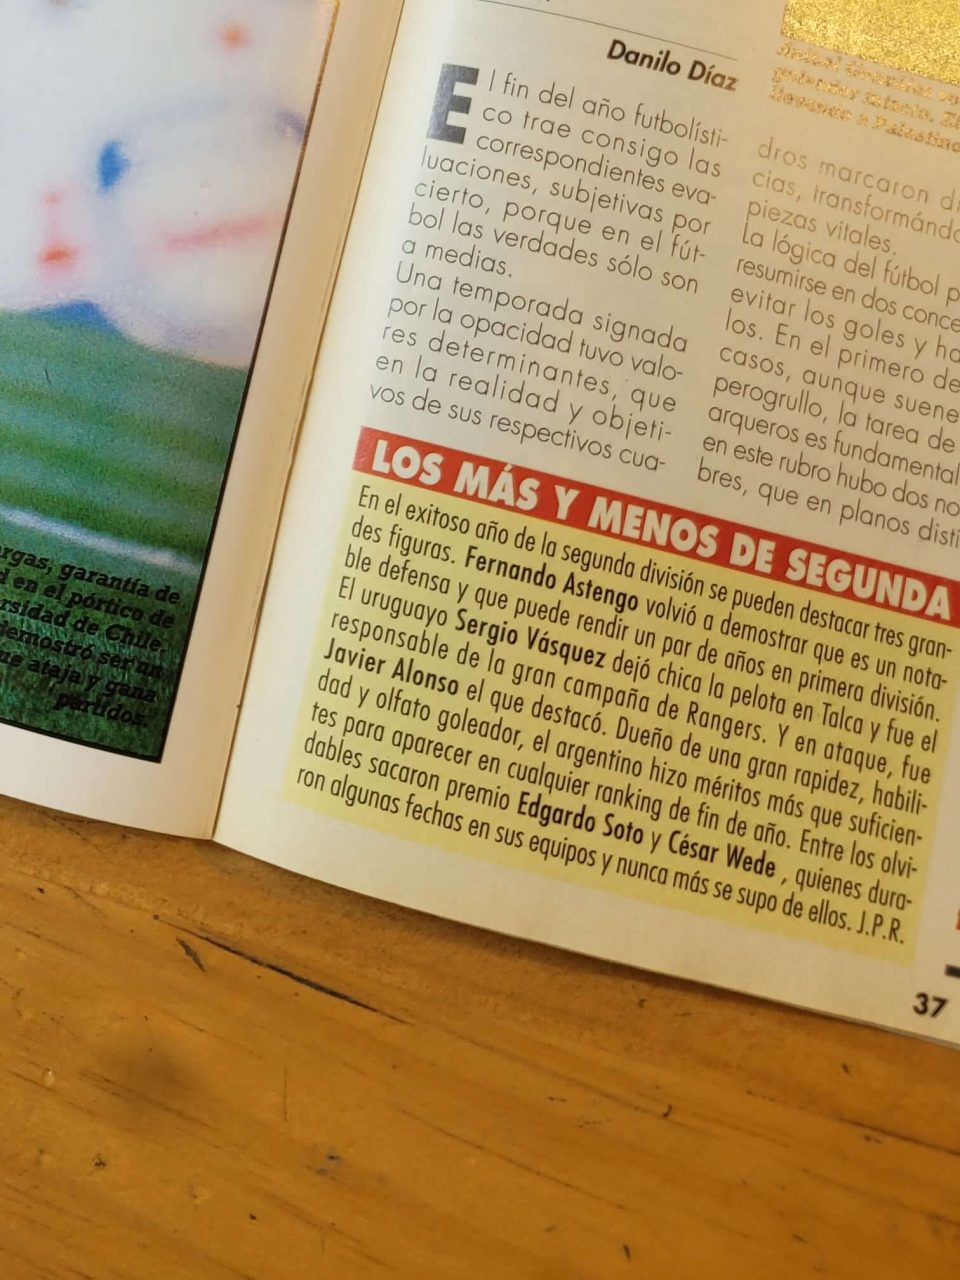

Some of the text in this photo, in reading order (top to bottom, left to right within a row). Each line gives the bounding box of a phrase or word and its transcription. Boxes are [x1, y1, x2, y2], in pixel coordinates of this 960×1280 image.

[606, 39, 738, 92] Danilo Díaz
[476, 135, 665, 193] correspondientes
[482, 107, 721, 177] co trae consigo las
[414, 180, 490, 215] cierto,
[502, 201, 592, 235] porque
[602, 225, 630, 245] en
[640, 229, 663, 253] el
[421, 145, 712, 235] luaciones, subjetivas por
[746, 200, 896, 256] piezas vitales.
[401, 239, 512, 278] a medias.
[408, 201, 698, 294] bol las verdades sólo son
[396, 260, 688, 353] Una temporada signada
[725, 306, 763, 341] los.
[775, 322, 801, 351] En
[810, 334, 831, 358] el
[837, 348, 924, 383] primero
[712, 376, 955, 453] perogrullo, la tarea de
[719, 347, 959, 424] casos, aunque suene
[358, 484, 379, 511] En
[384, 493, 402, 516] el
[405, 504, 470, 534] exitoso
[475, 521, 509, 545] año
[514, 525, 536, 552] de
[541, 531, 557, 558] la
[561, 544, 635, 578] segunda
[640, 558, 704, 597] división
[708, 583, 728, 602] se
[731, 589, 795, 620] pueden
[799, 600, 870, 639] destacar
[874, 622, 904, 648] tres
[371, 438, 952, 619] LOS MÁS Y MENOS DE SEGUNDA
[351, 514, 383, 543] des
[388, 523, 455, 564] figuras.
[464, 545, 556, 590] Fernando
[562, 571, 639, 614] Astengo
[646, 596, 697, 626] volvió
[703, 614, 714, 631] a
[720, 611, 809, 655] demostrar
[813, 642, 844, 665] que
[851, 652, 870, 671] es
[876, 658, 896, 679] un
[913, 992, 949, 1019] 37
